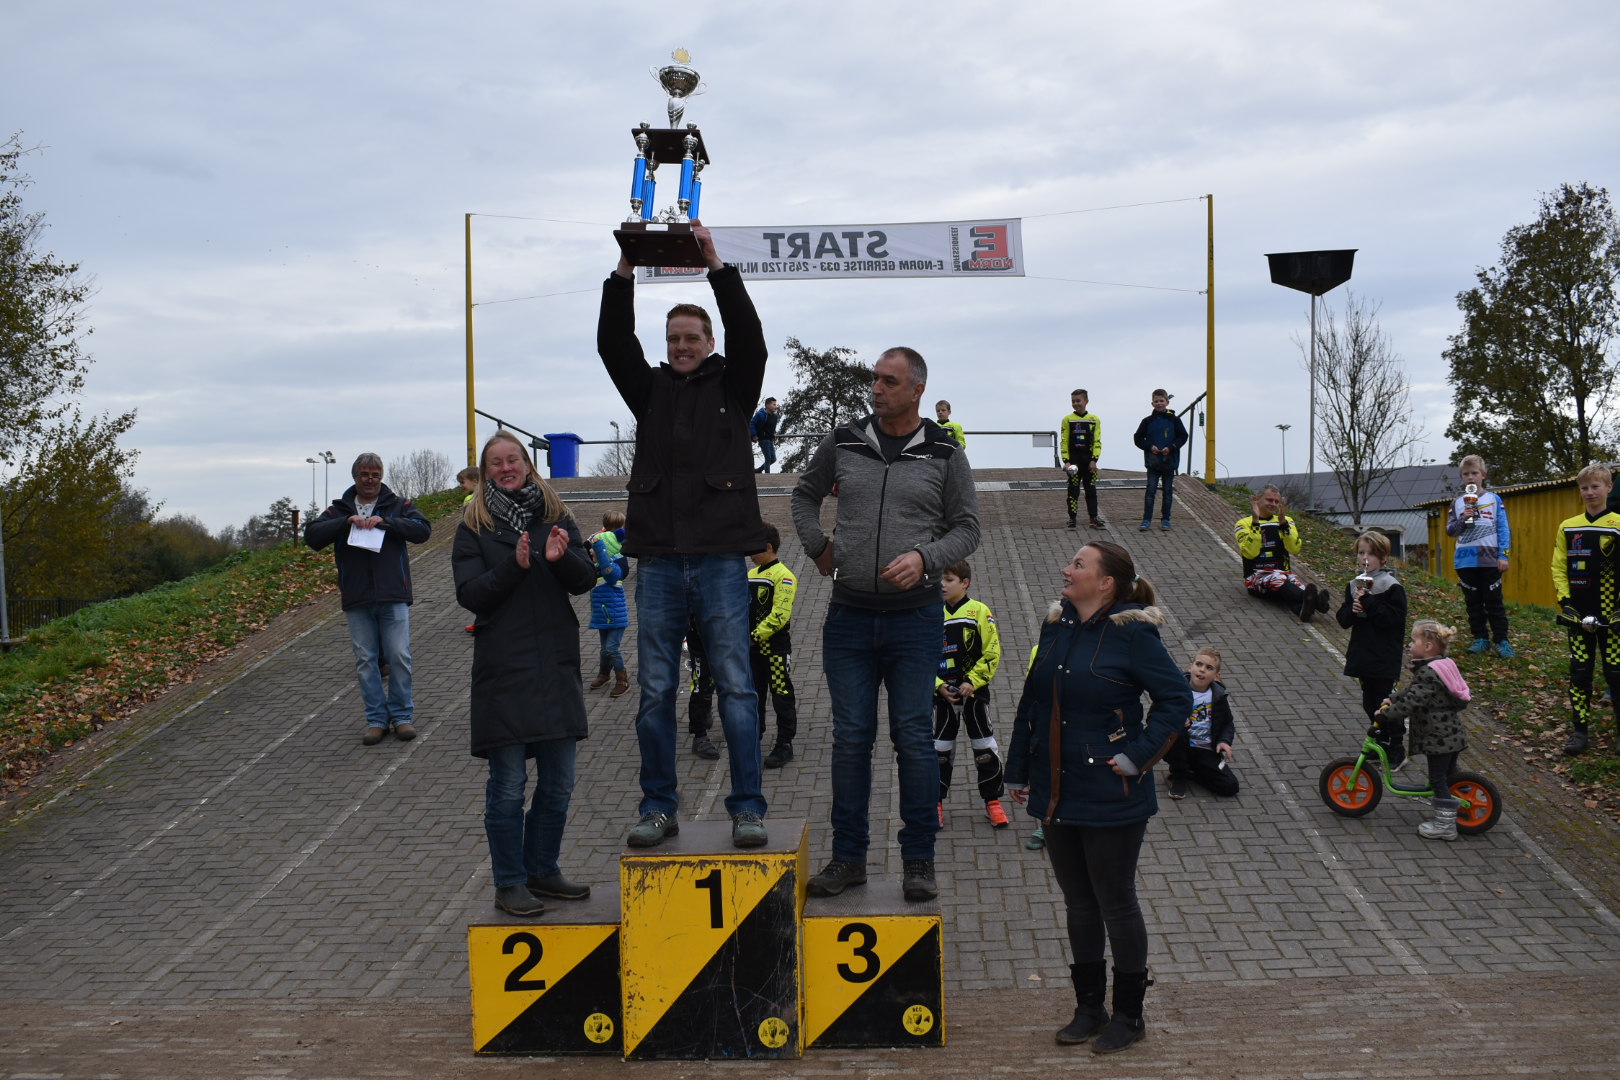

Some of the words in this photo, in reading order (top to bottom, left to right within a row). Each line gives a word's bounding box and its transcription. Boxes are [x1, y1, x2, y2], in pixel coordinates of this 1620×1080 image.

[694, 869, 724, 929] 1
[501, 932, 546, 992] 2
[836, 923, 881, 984] 3
